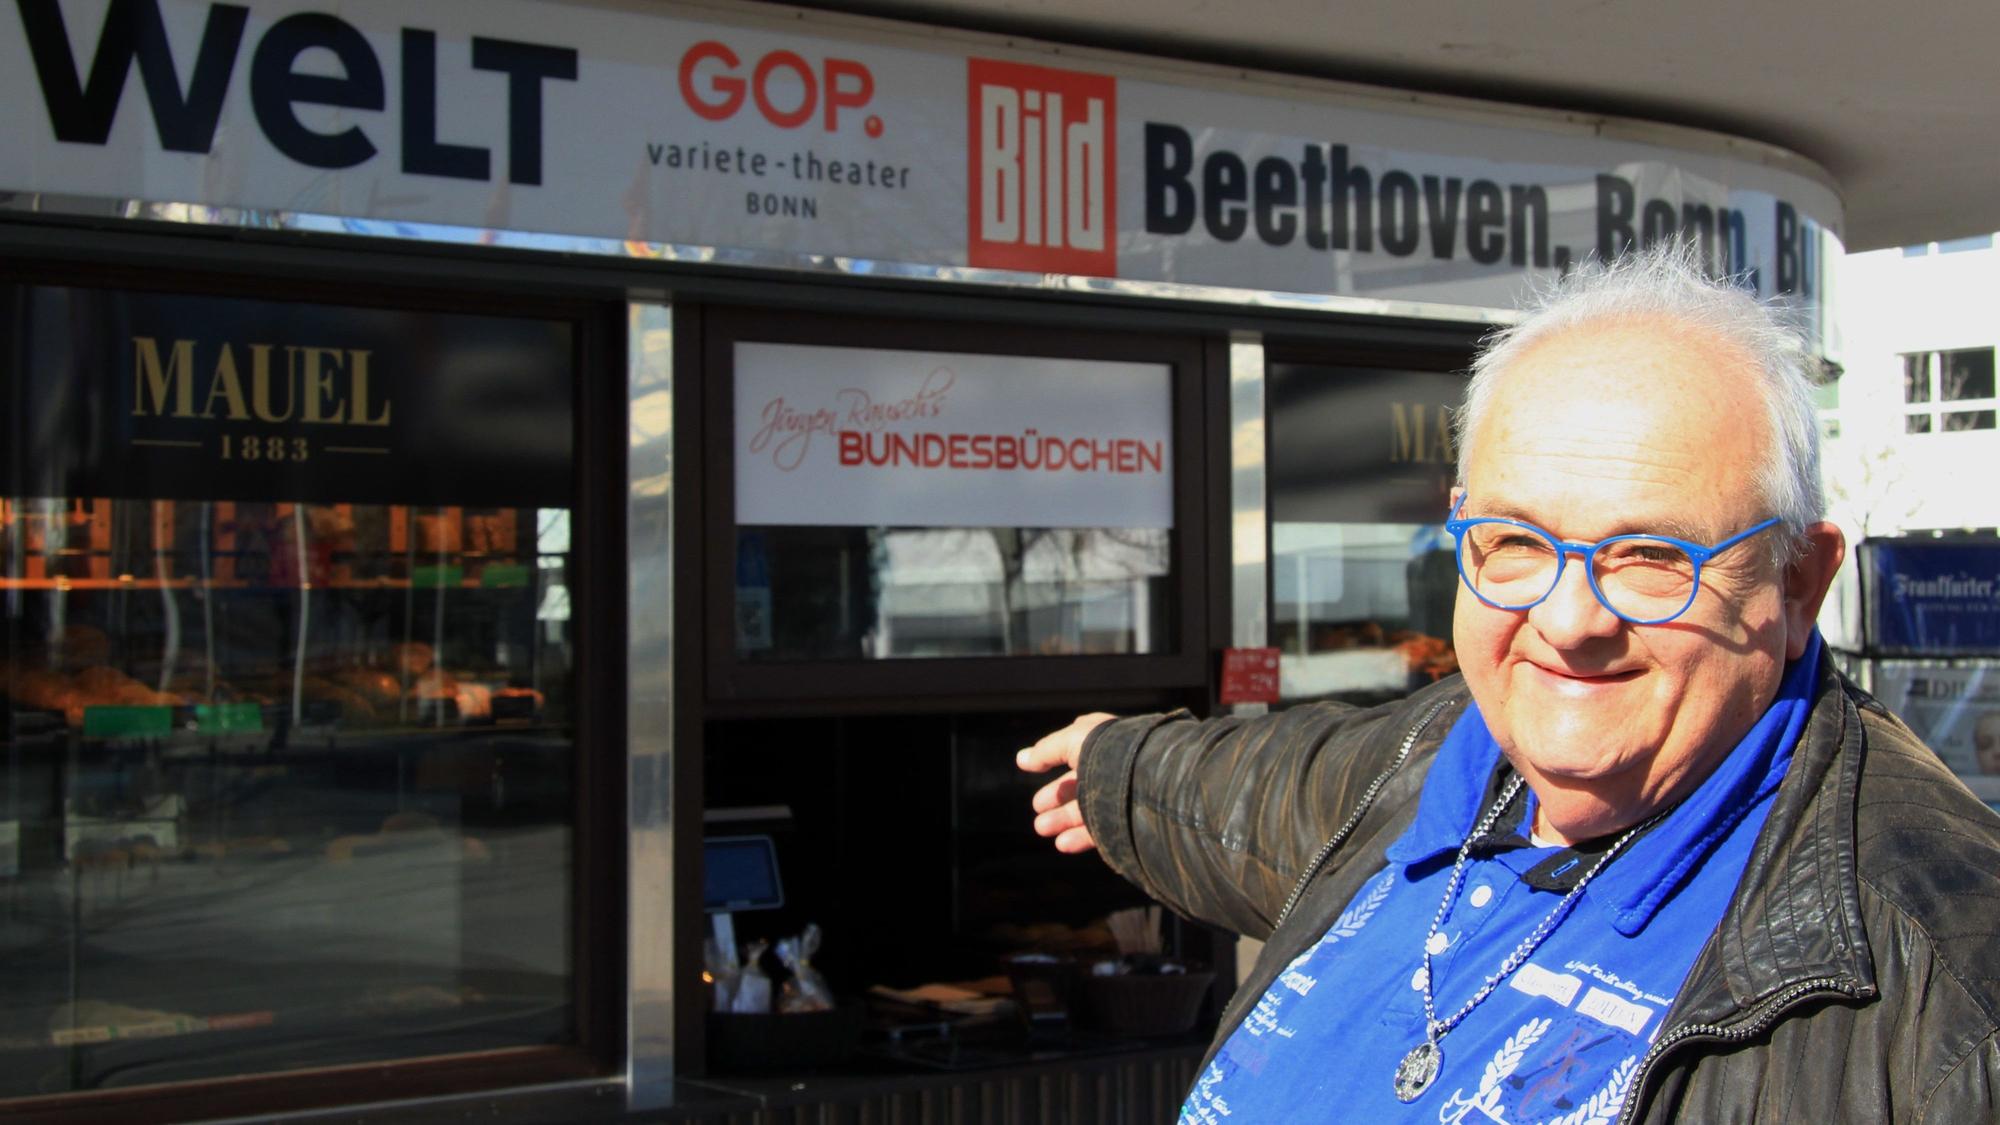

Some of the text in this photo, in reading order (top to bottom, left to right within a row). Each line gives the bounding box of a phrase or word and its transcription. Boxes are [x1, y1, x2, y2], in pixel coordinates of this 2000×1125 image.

[648, 142, 910, 189] variete-theater
[979, 83, 1105, 252] Bild
[746, 191, 818, 219] BONN
[131, 336, 391, 427] MAUEL
[219, 434, 310, 462] 1883
[838, 428, 1163, 474] BUNDESBÜDCHEN
[1390, 401, 1455, 465] MA
